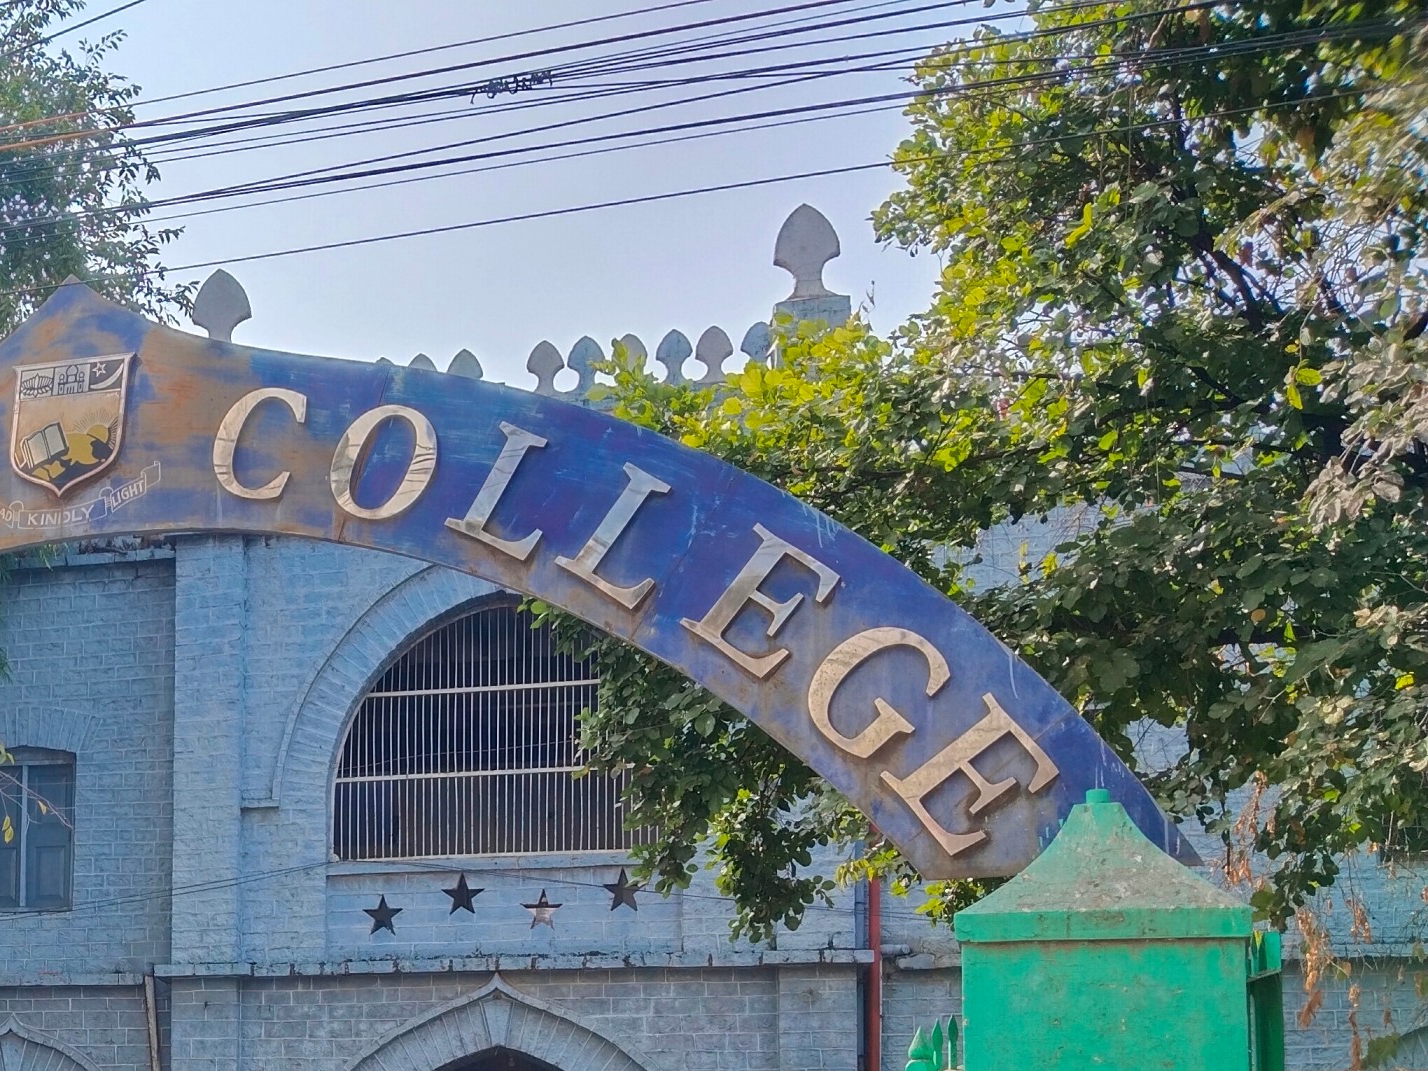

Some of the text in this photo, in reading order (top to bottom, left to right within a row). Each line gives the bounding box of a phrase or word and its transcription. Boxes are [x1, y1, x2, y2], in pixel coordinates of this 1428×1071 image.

[27, 504, 95, 526] KINDLY
[111, 480, 145, 506] LIGHT
[211, 386, 1060, 857] COLLEGE
